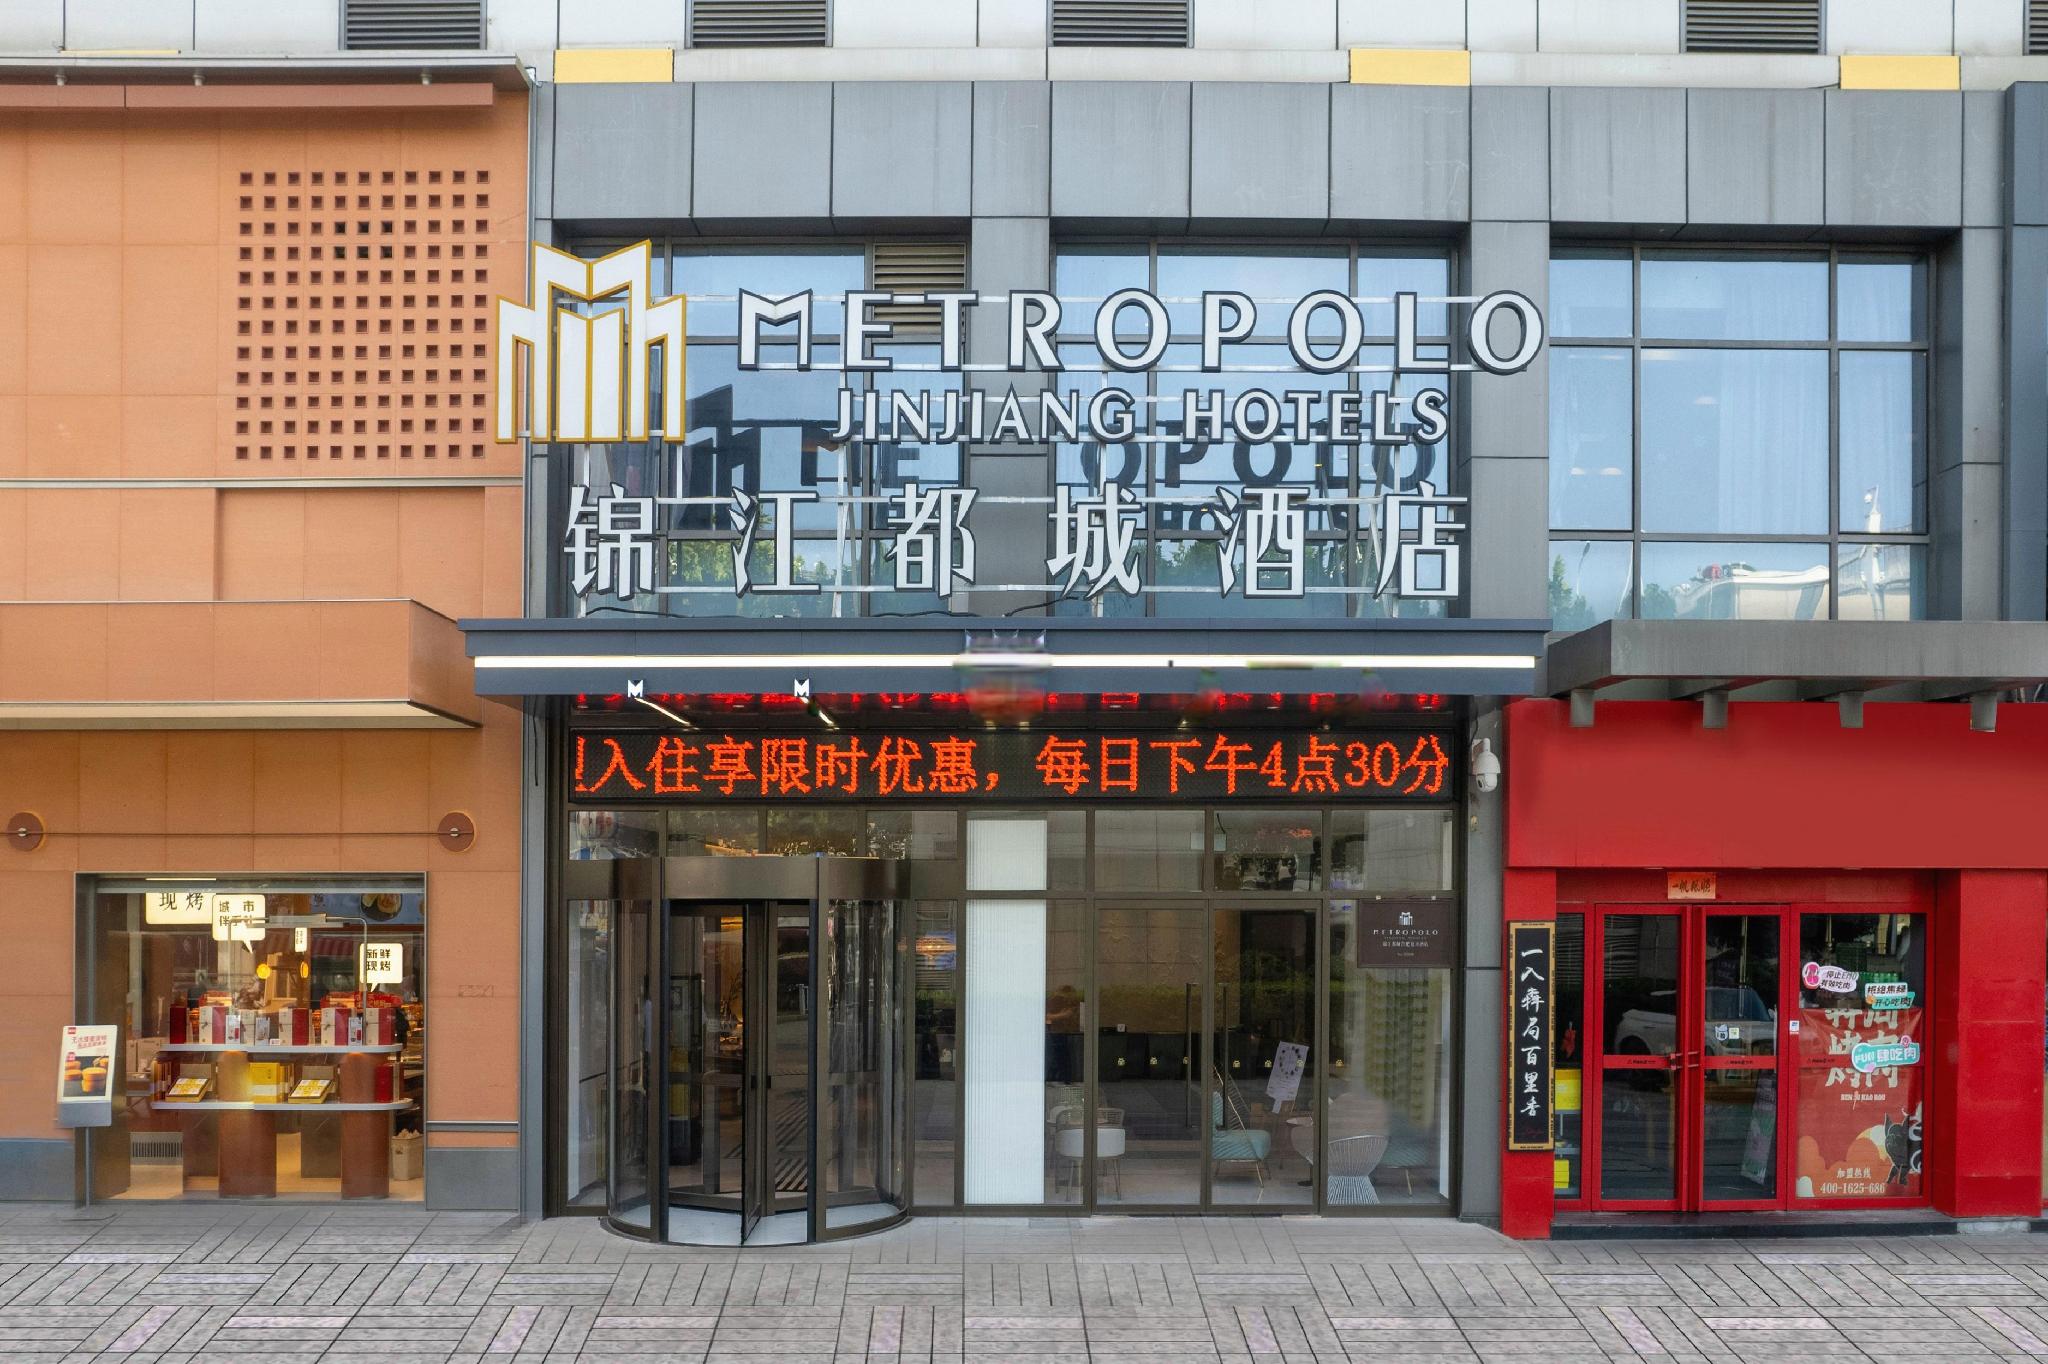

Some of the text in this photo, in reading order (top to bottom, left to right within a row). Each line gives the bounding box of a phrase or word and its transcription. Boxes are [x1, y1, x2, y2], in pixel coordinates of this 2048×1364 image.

[738, 287, 1544, 376] METROPOLO
[831, 381, 1449, 446] JINJIANG HOTELS
[563, 480, 1467, 600] 锦江都城酒店
[574, 733, 1449, 795] 入住享限时优惠，每日下午4点30分
